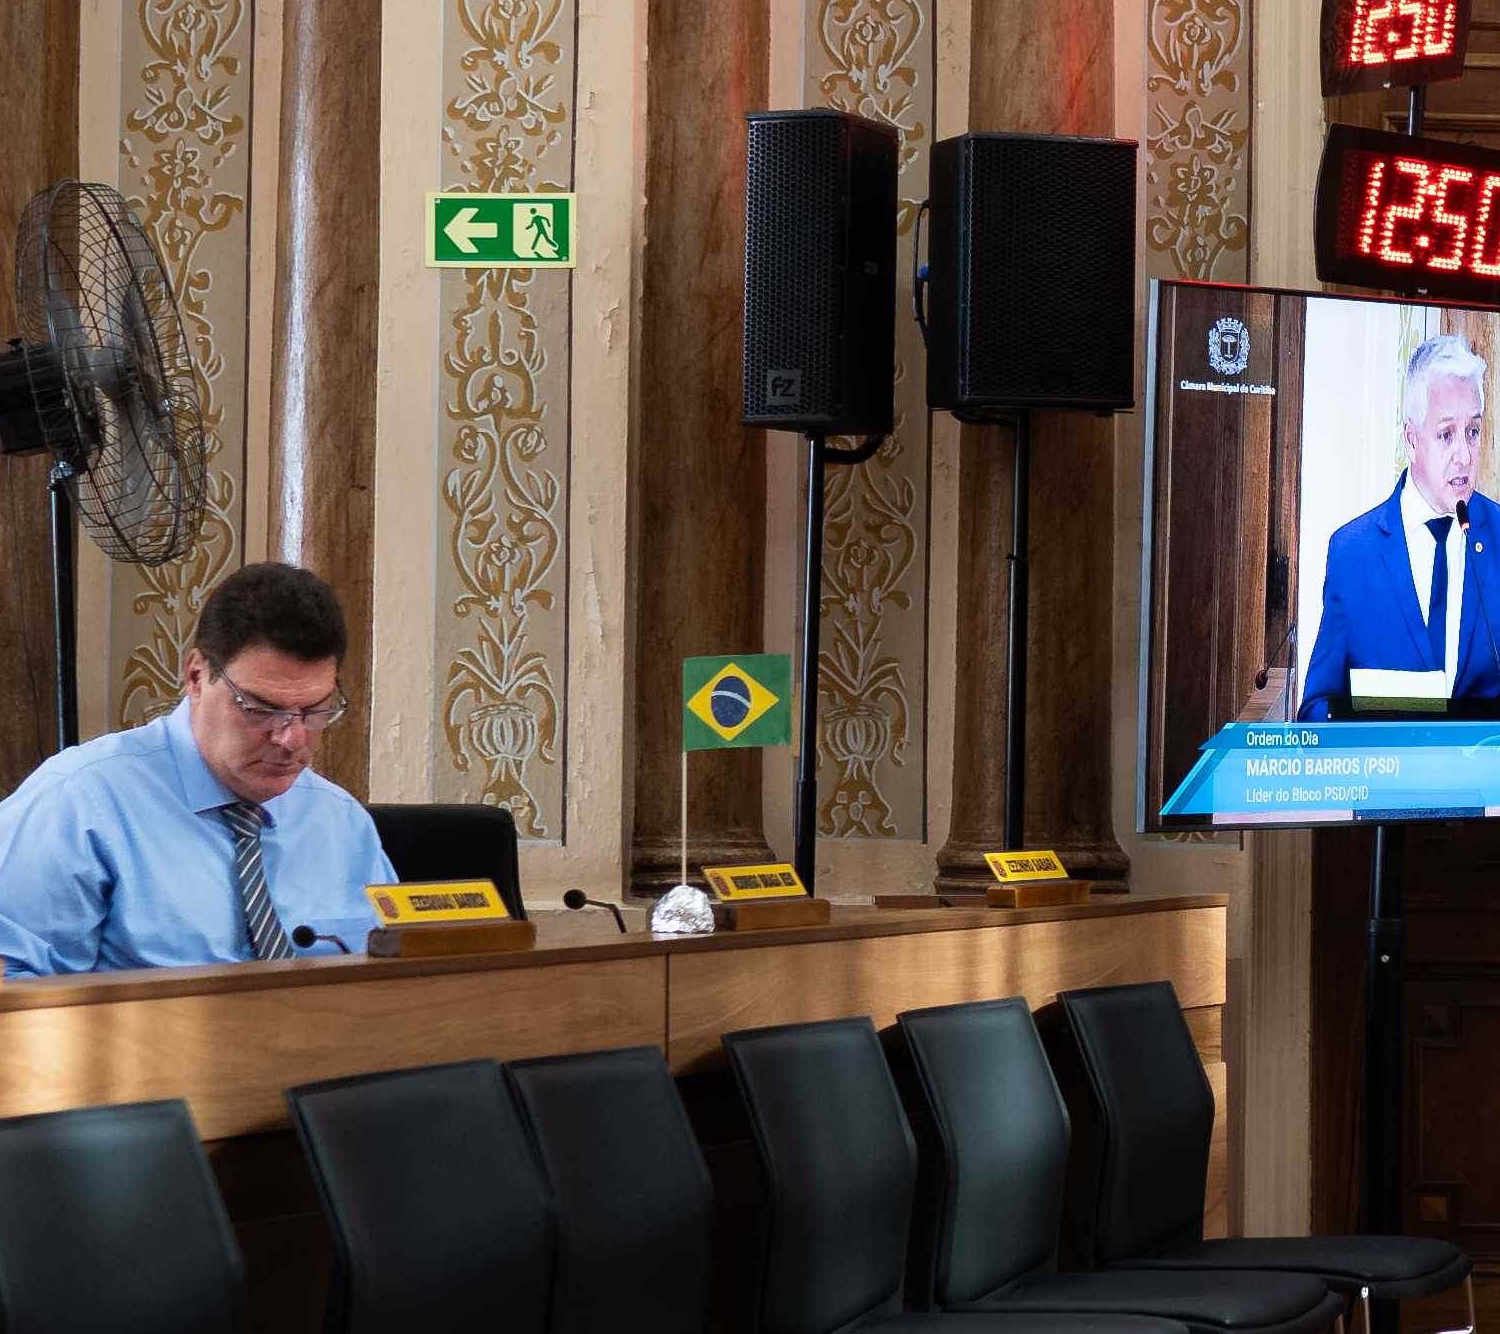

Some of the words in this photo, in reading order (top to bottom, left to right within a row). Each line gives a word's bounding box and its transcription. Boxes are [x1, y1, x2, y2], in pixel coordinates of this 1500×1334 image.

[1246, 731, 1283, 746] Ordem
[1285, 730, 1300, 745] do
[1301, 730, 1319, 746] Dia
[1246, 754, 1302, 777] MÁRCIO
[1304, 757, 1361, 776] BARROS
[1363, 756, 1400, 779] (PSD)
[1246, 787, 1274, 803] Líder
[1275, 787, 1290, 803] do
[1292, 787, 1322, 802] Bloco
[1324, 785, 1369, 803] PSD/CID
